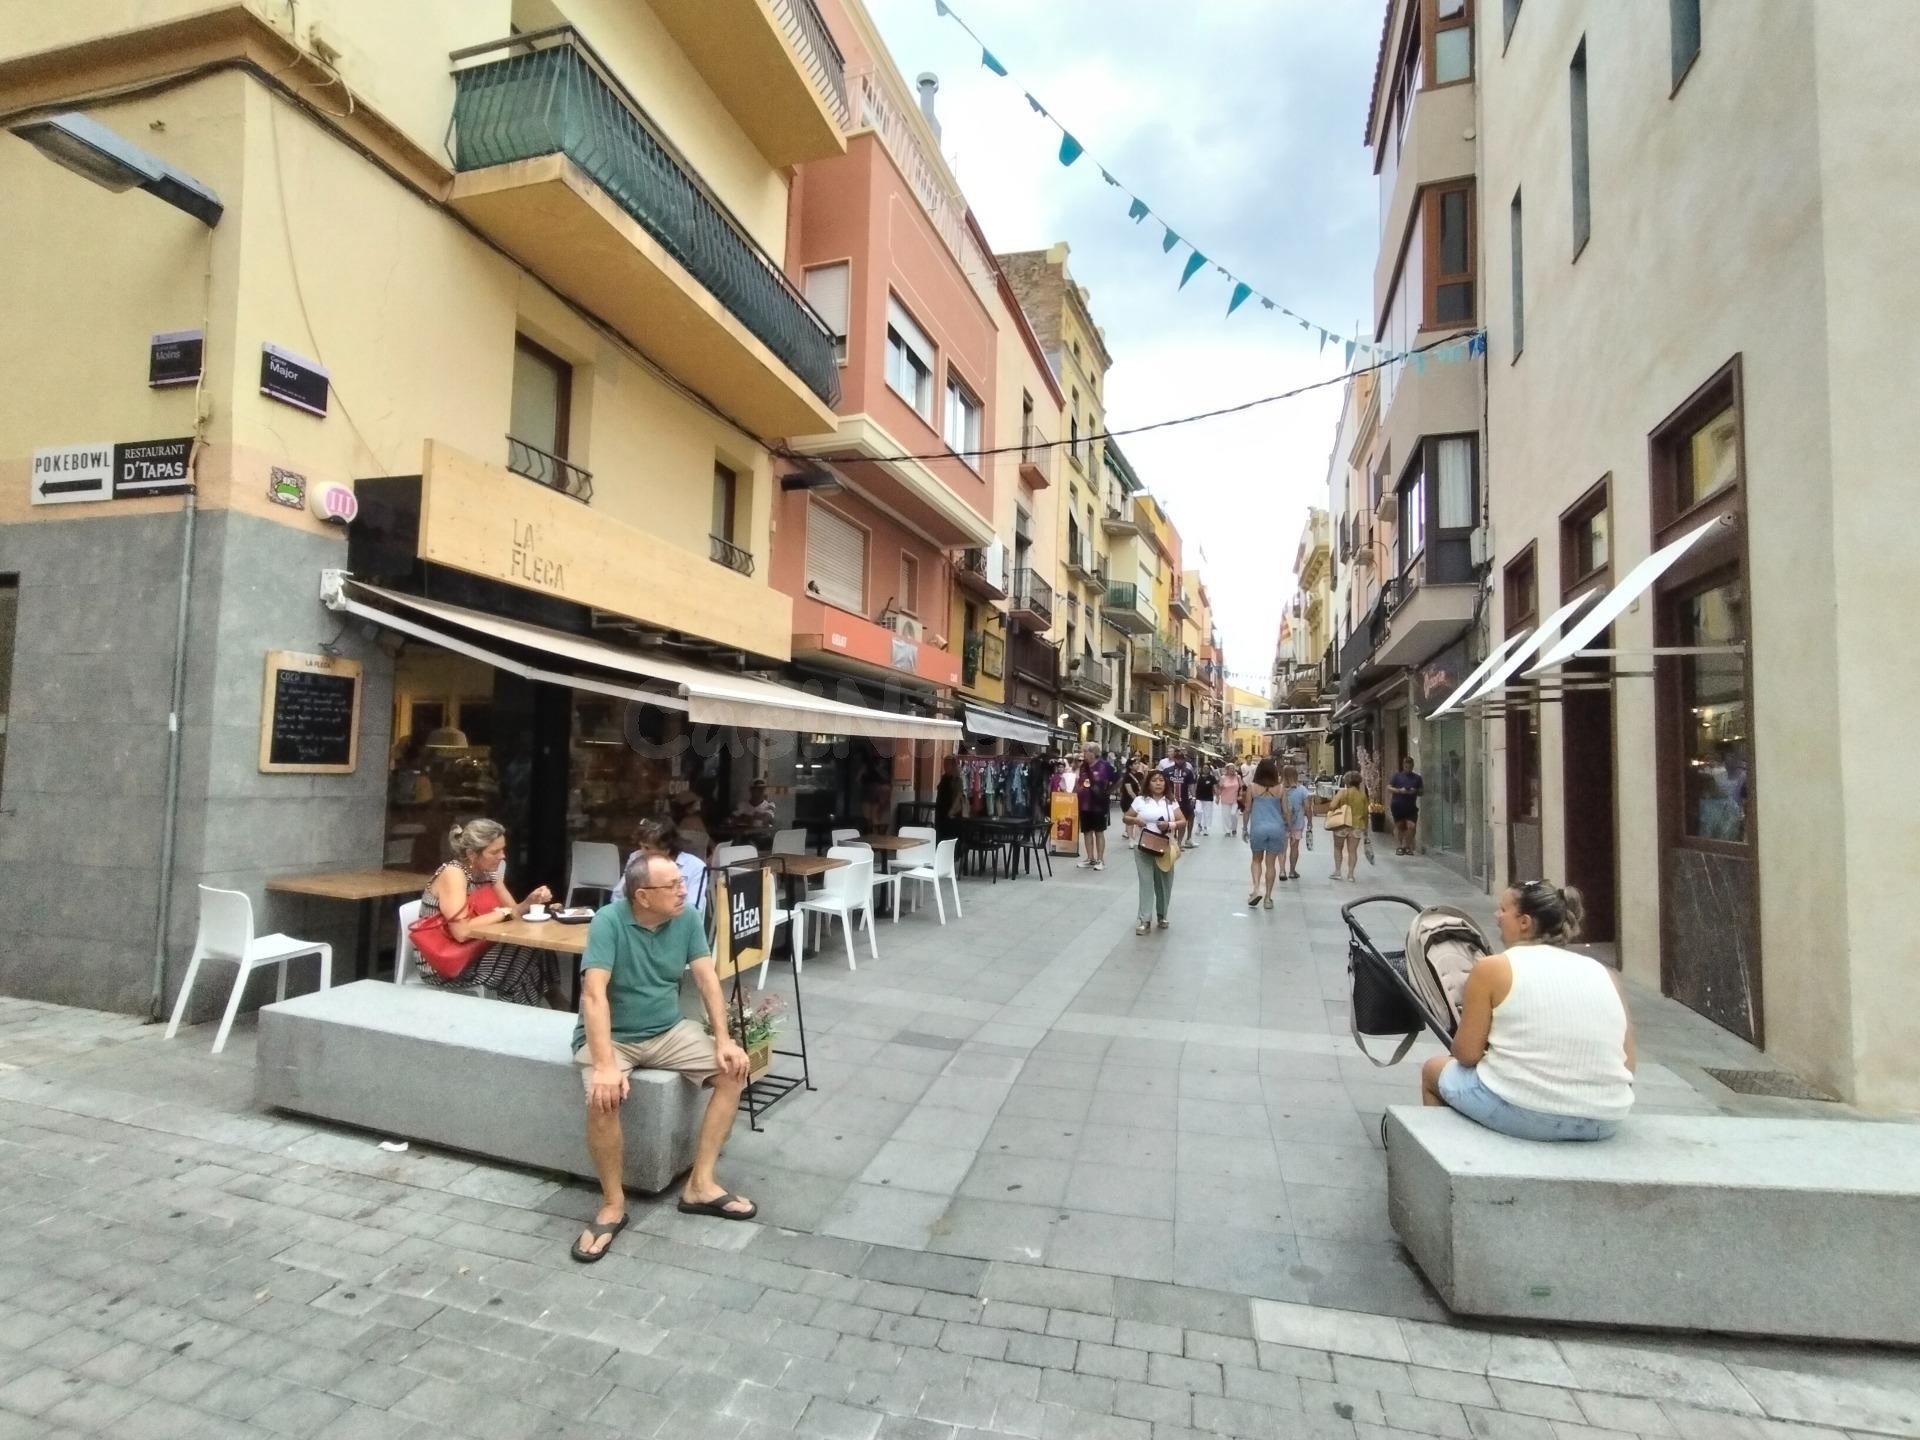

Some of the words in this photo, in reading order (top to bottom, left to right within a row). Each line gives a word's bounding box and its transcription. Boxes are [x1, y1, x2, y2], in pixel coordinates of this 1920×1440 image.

[270, 361, 299, 380] Major
[35, 451, 111, 474] POKEBOWL
[124, 444, 185, 459] RESTAURANT
[512, 517, 535, 553] LA
[733, 892, 745, 913] LA
[733, 906, 760, 933] FLECA
